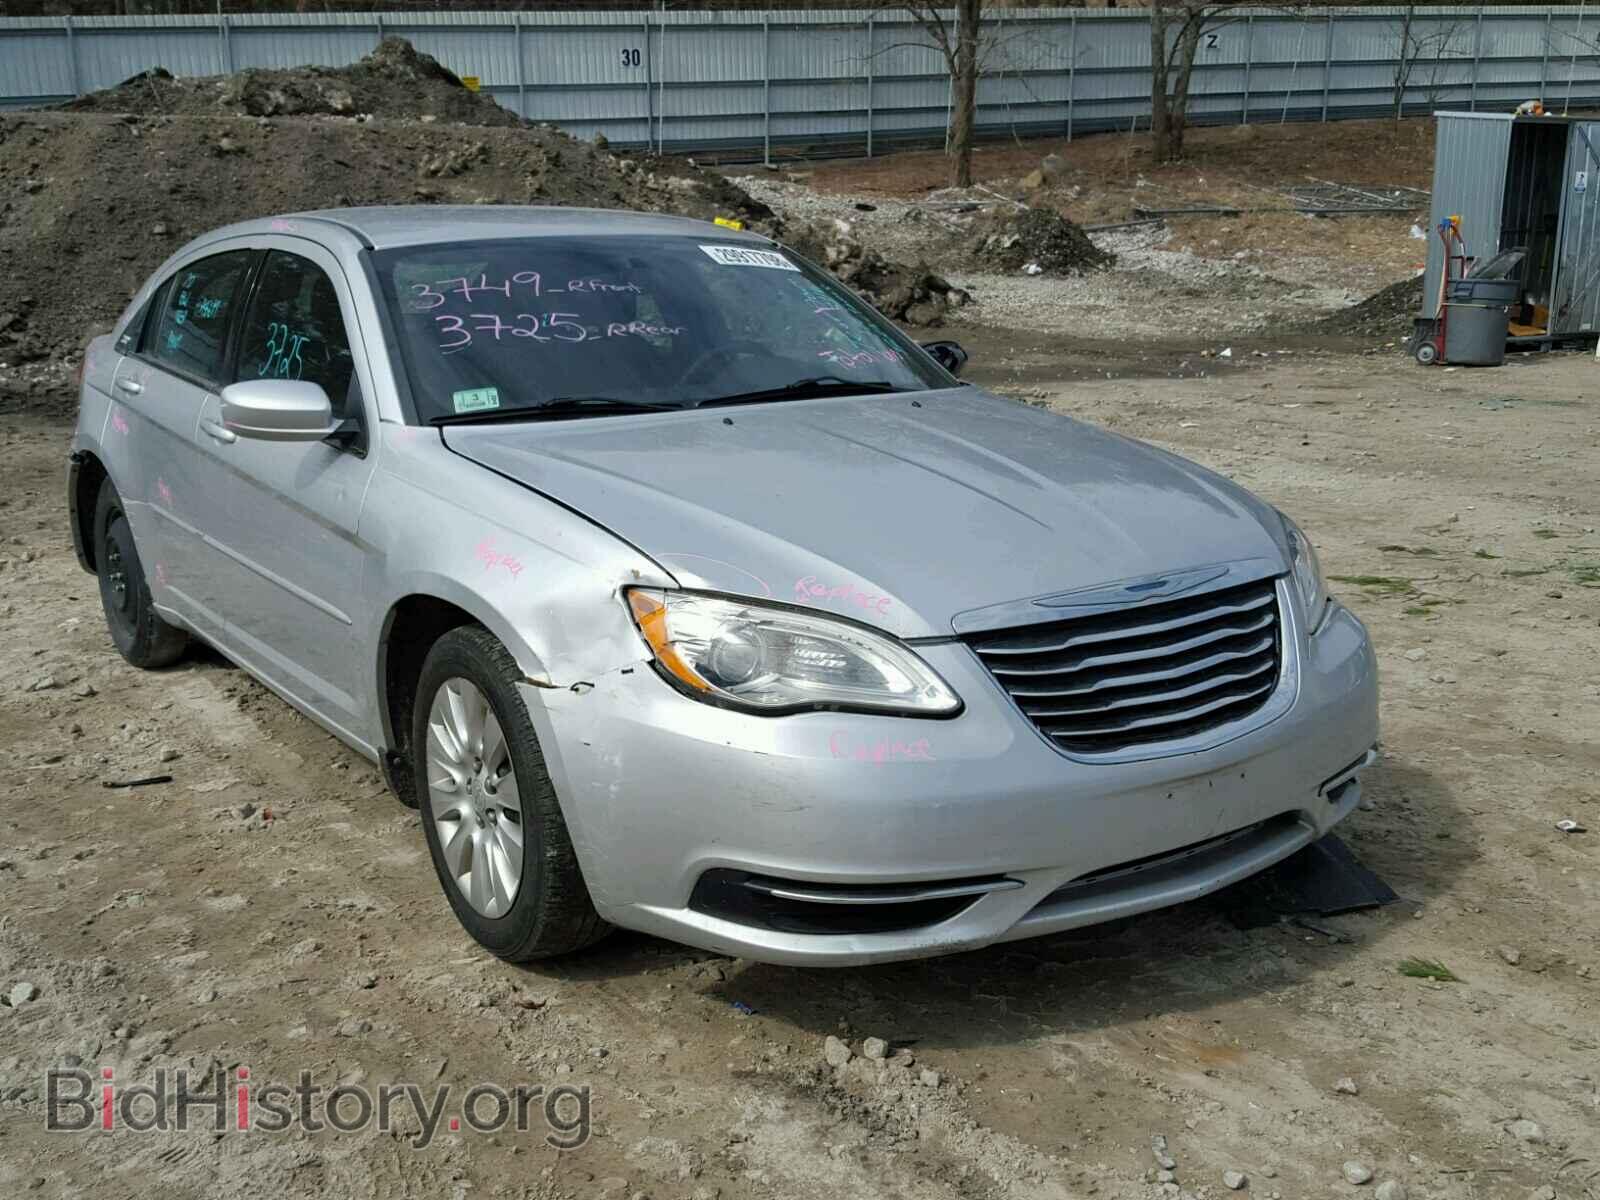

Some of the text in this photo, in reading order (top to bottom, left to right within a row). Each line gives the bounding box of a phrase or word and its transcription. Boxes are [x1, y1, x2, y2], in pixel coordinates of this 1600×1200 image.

[622, 48, 640, 66] 30
[411, 271, 541, 309] 3749
[435, 312, 586, 349] 3725
